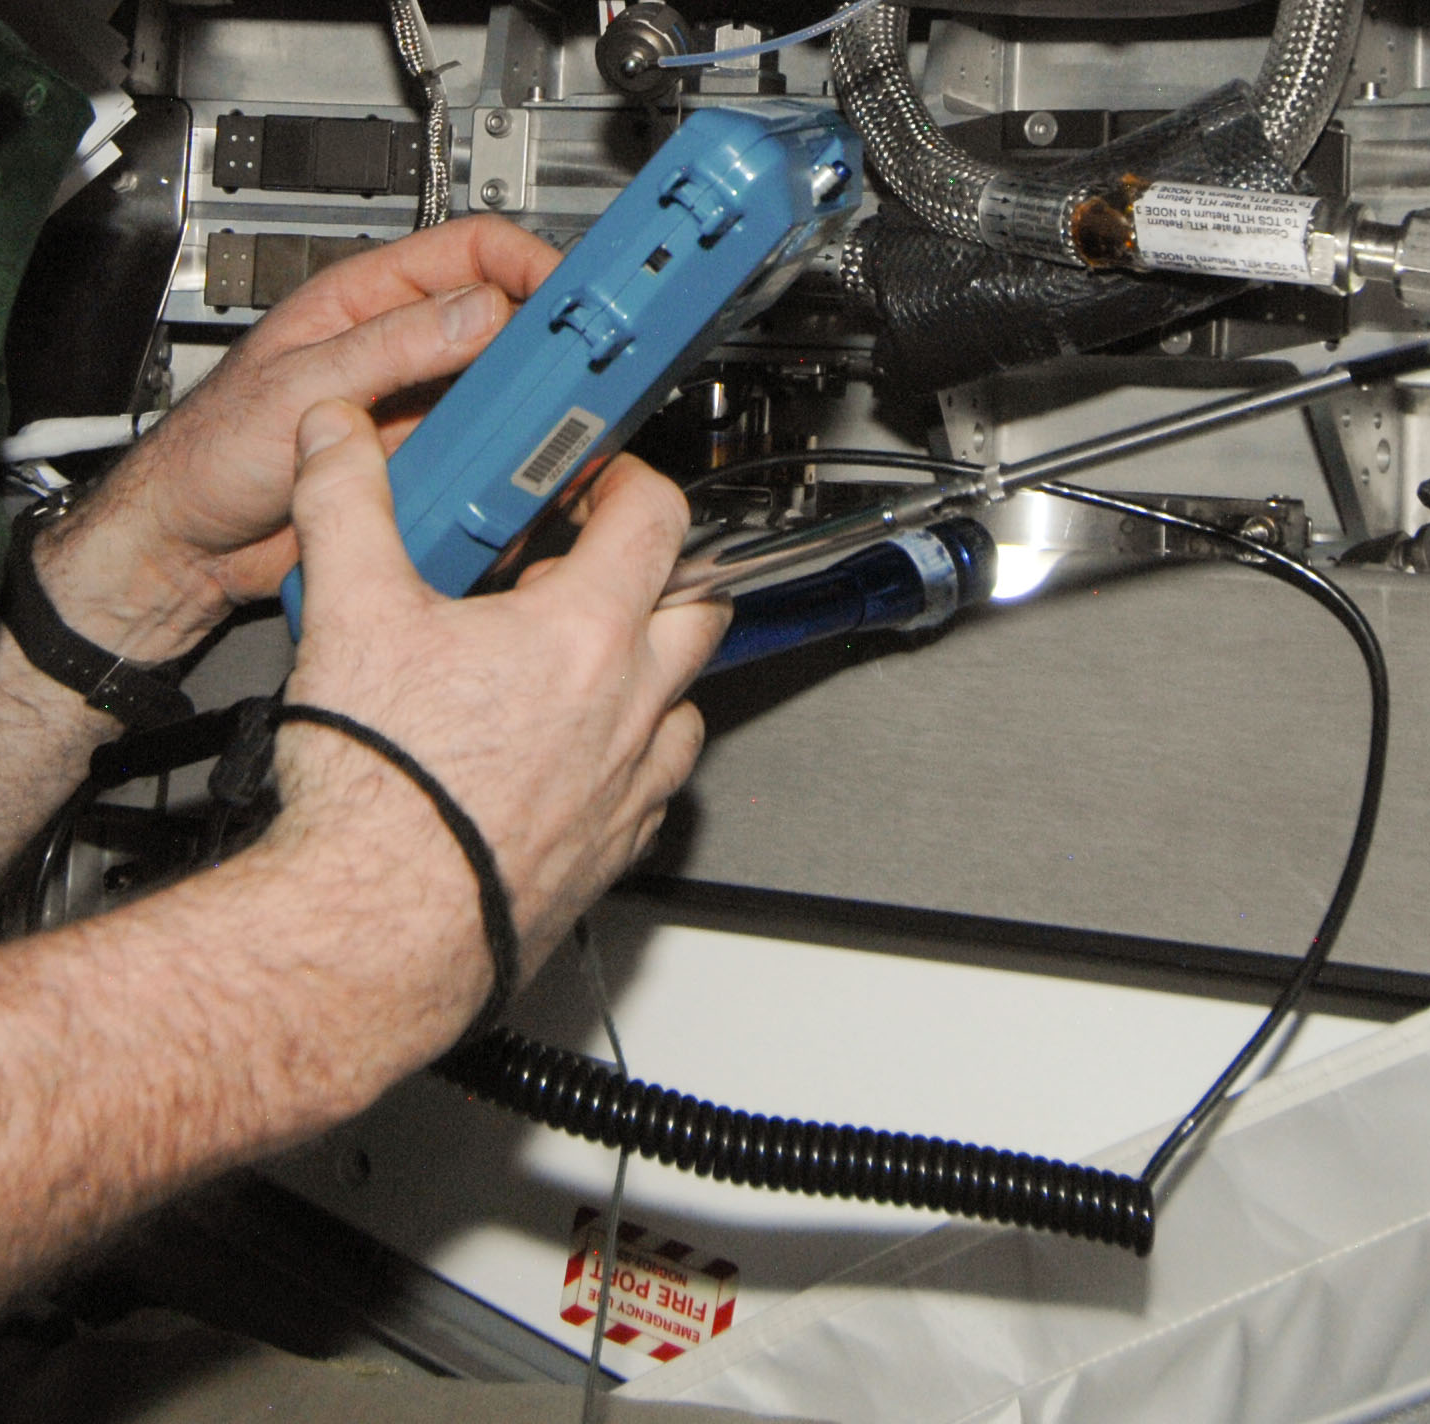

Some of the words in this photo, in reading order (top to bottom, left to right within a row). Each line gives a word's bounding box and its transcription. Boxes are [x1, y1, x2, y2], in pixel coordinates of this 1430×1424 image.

[1196, 196, 1217, 207] HTL
[1135, 205, 1142, 214] 3
[1145, 205, 1177, 218] NODE
[1180, 209, 1191, 218] to
[1194, 209, 1230, 222] Return
[1147, 217, 1183, 229] Return
[1233, 212, 1254, 224] HTL
[1257, 215, 1281, 227] TCS
[1284, 217, 1299, 228] To
[1186, 220, 1208, 231] HTL
[1212, 222, 1242, 236] Water
[1246, 225, 1289, 239] Coolant
[656, 1284, 708, 1323] FIRE
[617, 1300, 701, 1345] EMERGENCY
